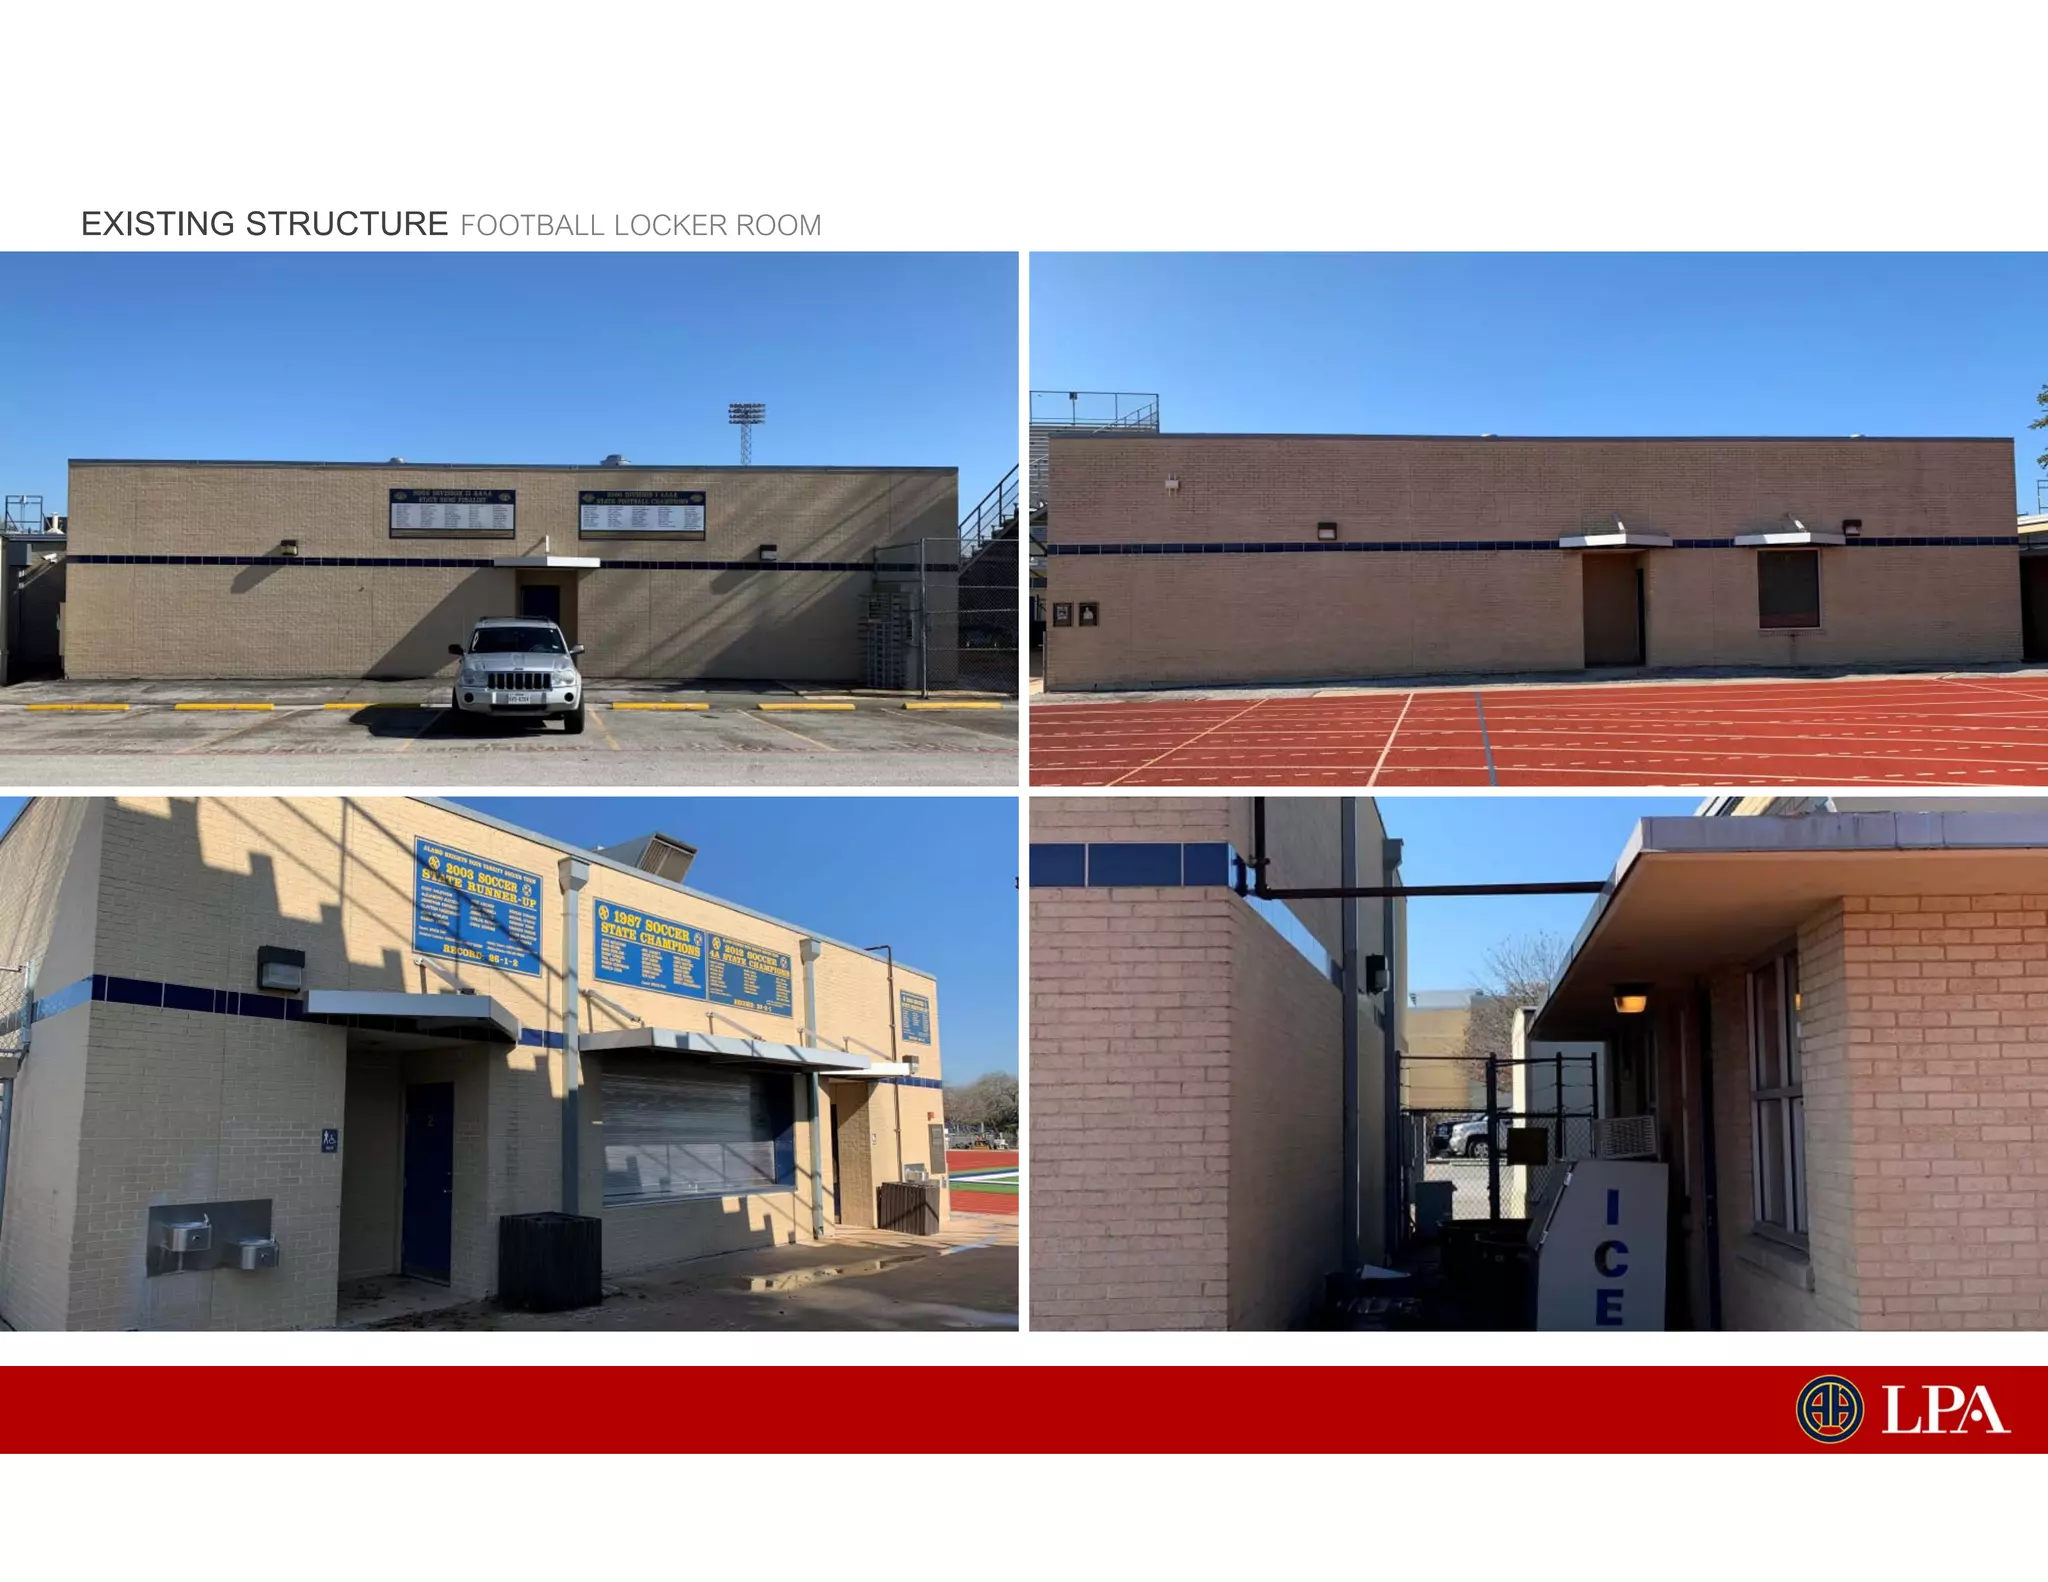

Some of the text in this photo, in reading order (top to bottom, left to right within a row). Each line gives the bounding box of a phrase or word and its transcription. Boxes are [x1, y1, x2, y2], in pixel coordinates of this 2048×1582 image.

[422, 868, 463, 889] STATE
[468, 880, 537, 908] RUNNER-UP
[446, 863, 518, 893] 2003 SOCCER
[601, 921, 637, 941] STATE
[640, 932, 701, 958] CHAMPIONS
[614, 910, 690, 943] 1987 SOCCER
[723, 953, 747, 966] STATE
[748, 960, 790, 978] CHAMPIONS
[724, 944, 744, 957] 2012
[747, 951, 778, 967] SOCCER
[1594, 1188, 1629, 1326] ICE
